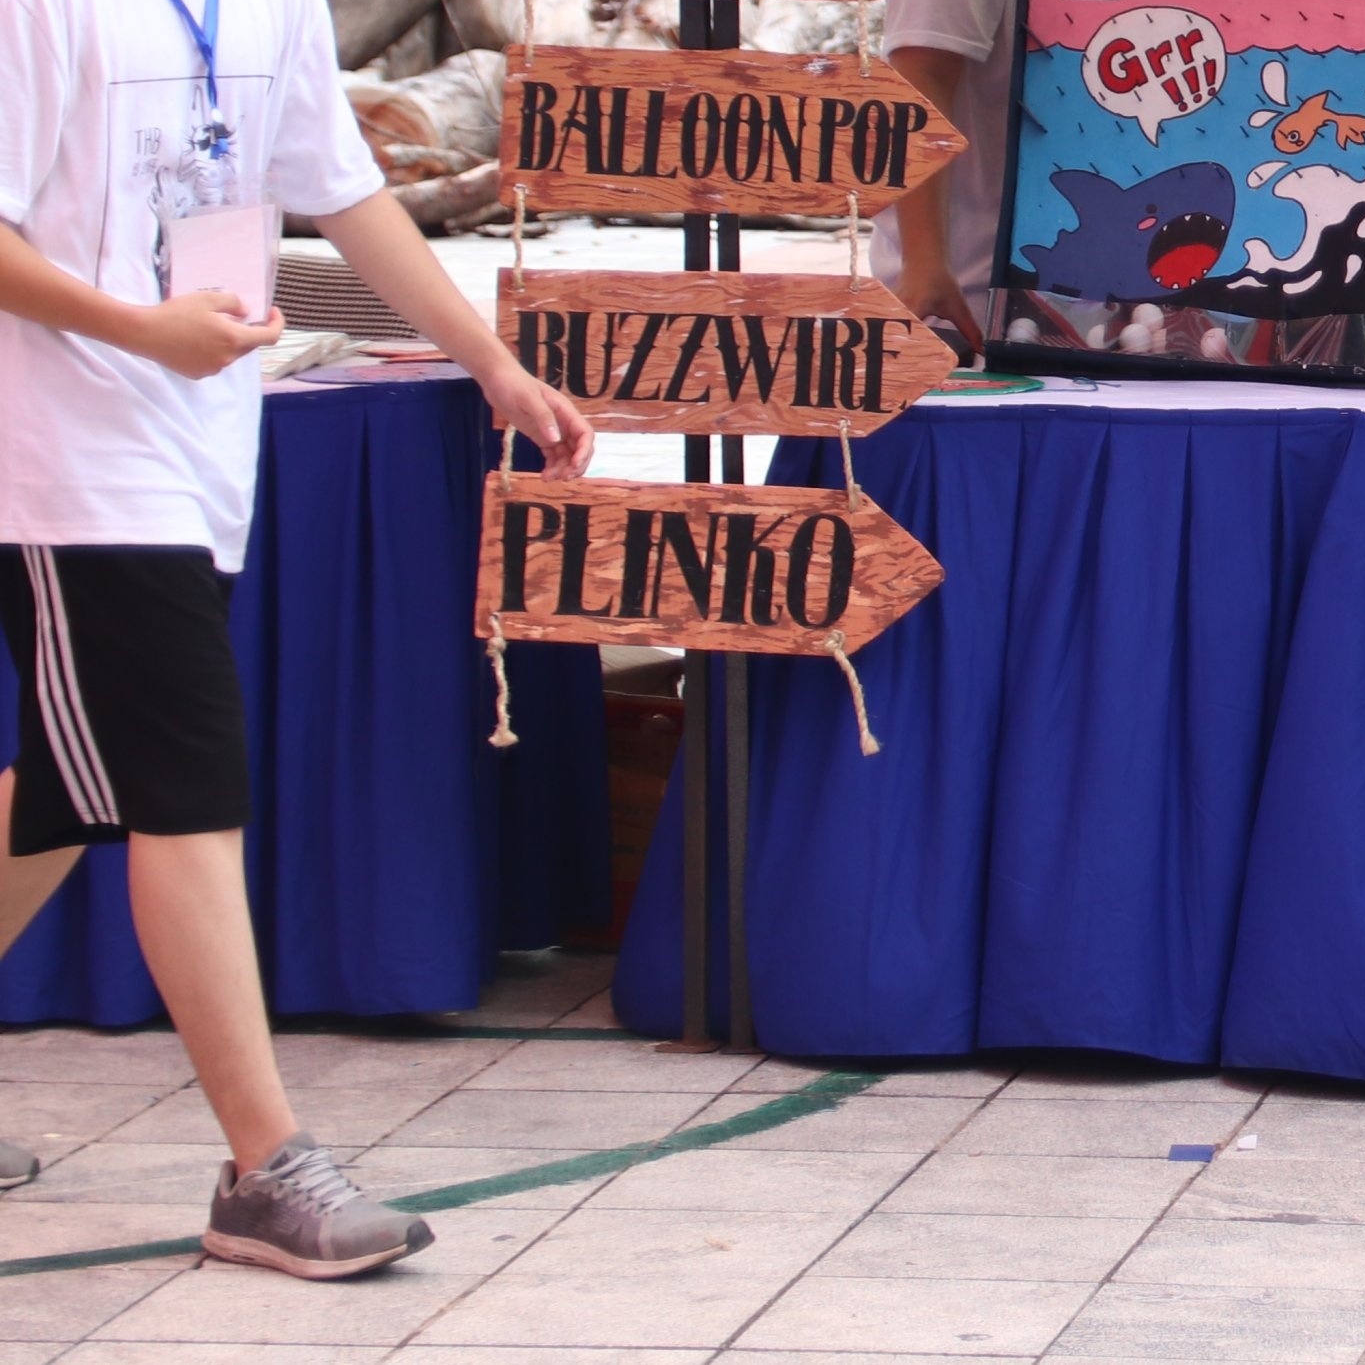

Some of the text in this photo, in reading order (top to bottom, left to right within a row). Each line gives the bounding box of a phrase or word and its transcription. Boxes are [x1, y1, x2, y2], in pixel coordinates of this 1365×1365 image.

[516, 81, 928, 189] BALLOON POP
[500, 502, 856, 630] PLINKO
